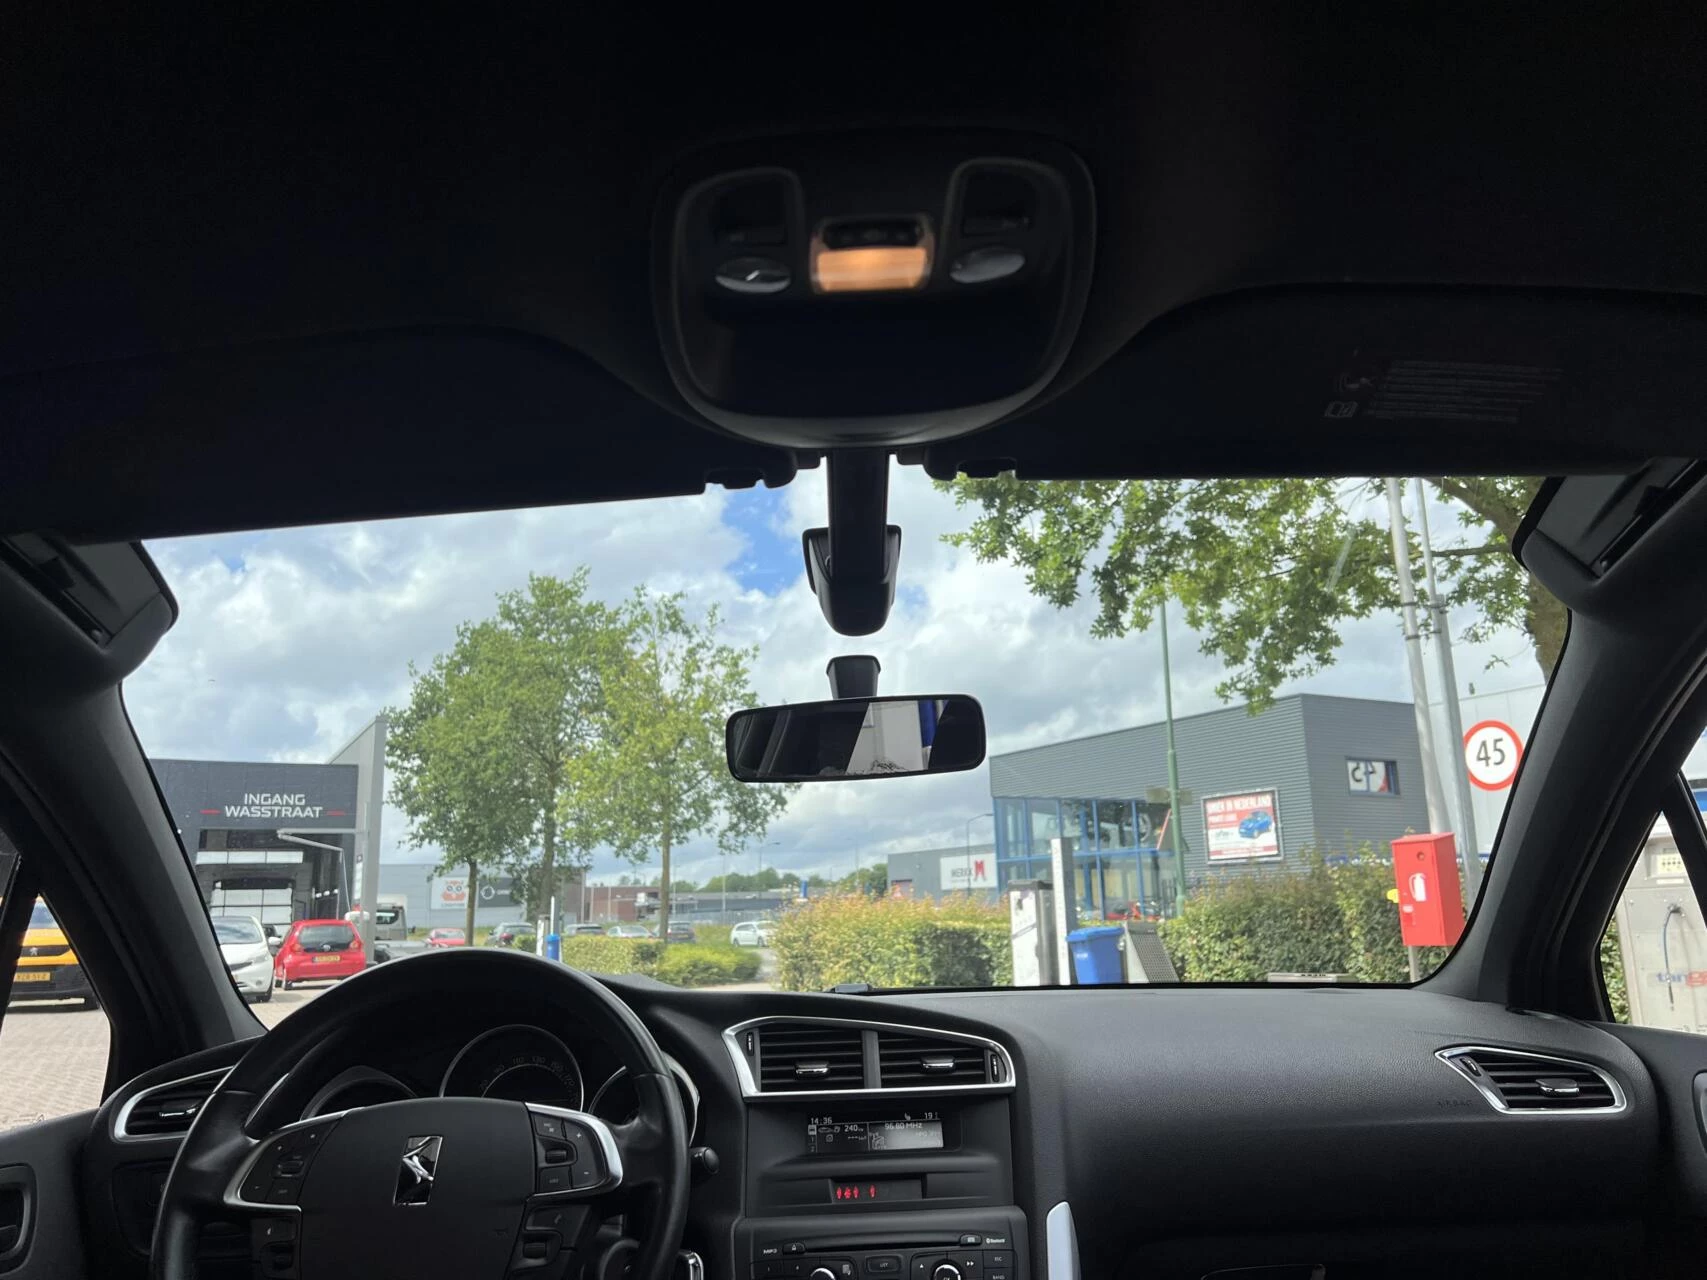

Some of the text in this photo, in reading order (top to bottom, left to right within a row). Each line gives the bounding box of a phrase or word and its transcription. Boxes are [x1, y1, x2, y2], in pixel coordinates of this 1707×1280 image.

[1476, 737, 1506, 767] 45
[243, 793, 305, 805] INGANG
[224, 805, 323, 817] WASSTRAAT
[844, 1124, 858, 1132] 240
